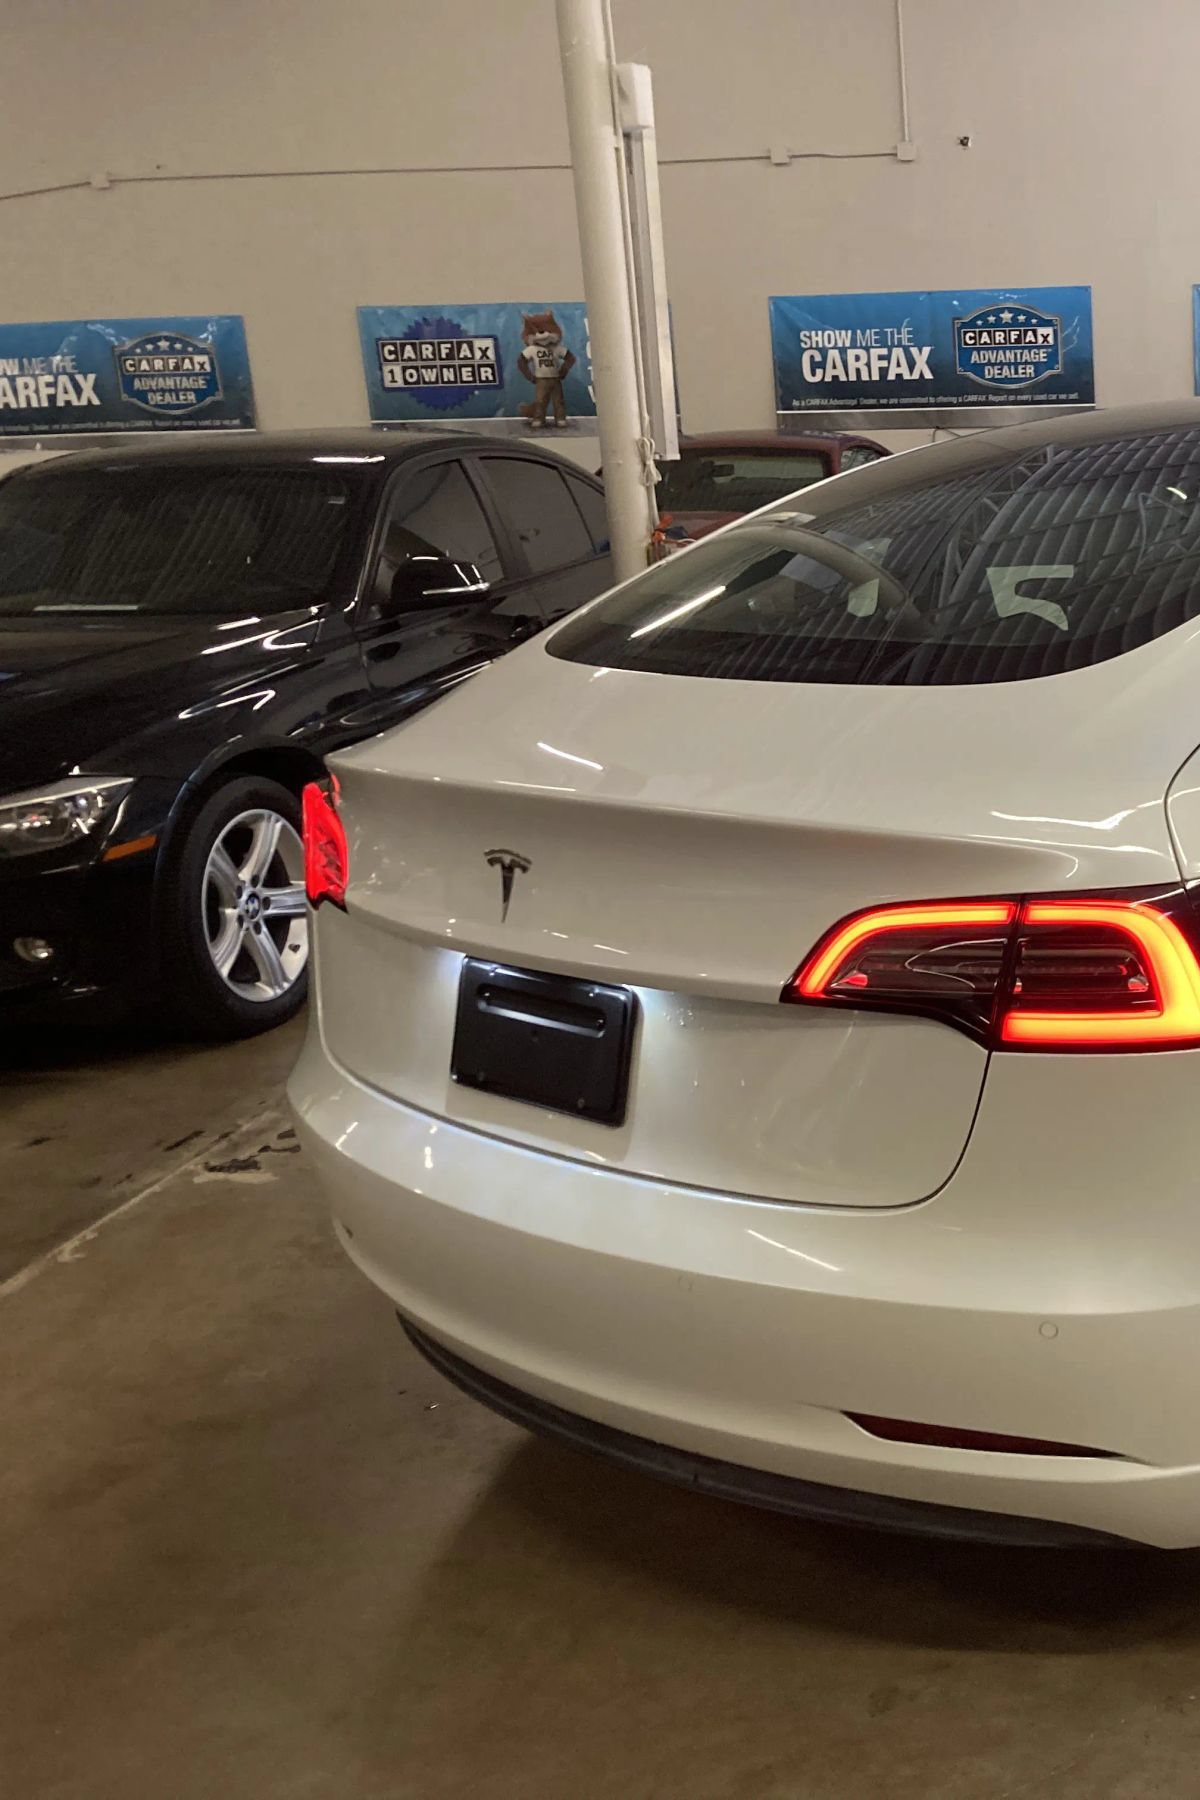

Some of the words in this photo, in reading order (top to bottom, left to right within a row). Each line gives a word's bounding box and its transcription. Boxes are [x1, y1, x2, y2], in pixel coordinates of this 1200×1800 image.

[800, 329, 852, 348] SHOW
[856, 329, 881, 347] ME
[884, 327, 915, 346] THE
[964, 330, 1051, 345] CARFAX
[382, 342, 491, 361] CARFAX
[970, 348, 1048, 364] ADVANTAGE
[124, 357, 207, 372] CARFAX
[802, 346, 934, 383] CARFAX
[984, 364, 1035, 379] DEALER
[134, 375, 208, 390] ADVANTAGE
[0, 373, 101, 409] ARFAX
[147, 391, 197, 405] DEALER
